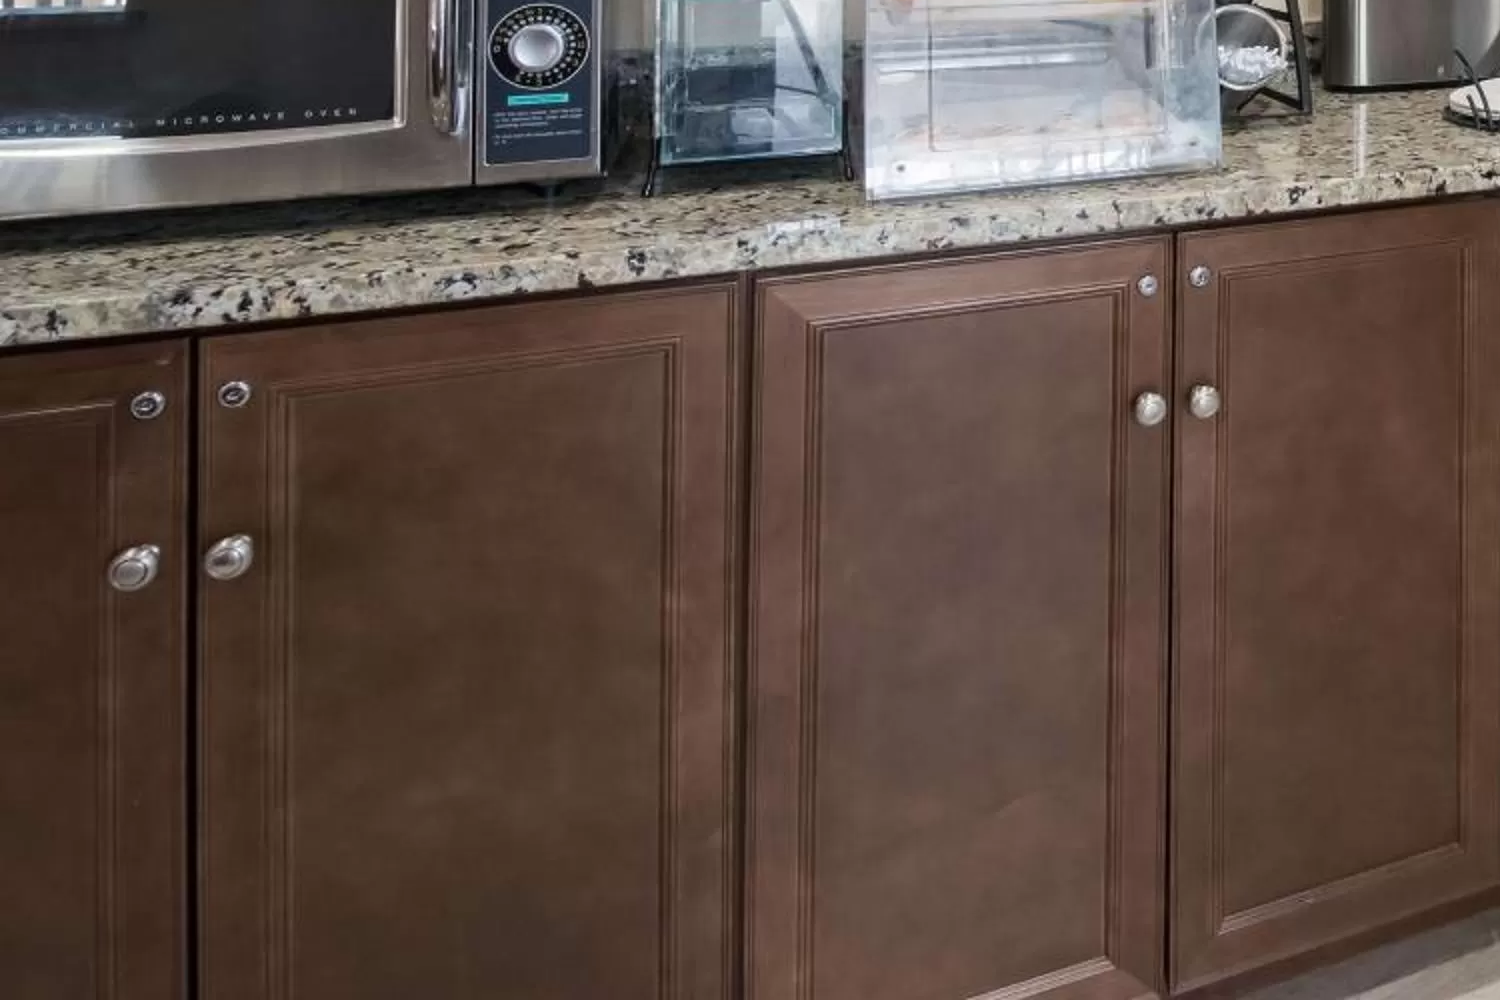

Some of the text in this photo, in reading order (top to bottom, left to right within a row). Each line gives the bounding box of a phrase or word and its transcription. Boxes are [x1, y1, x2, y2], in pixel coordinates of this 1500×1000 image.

[0, 107, 357, 134] OMMERCIAL MICROWAVE OVEN
